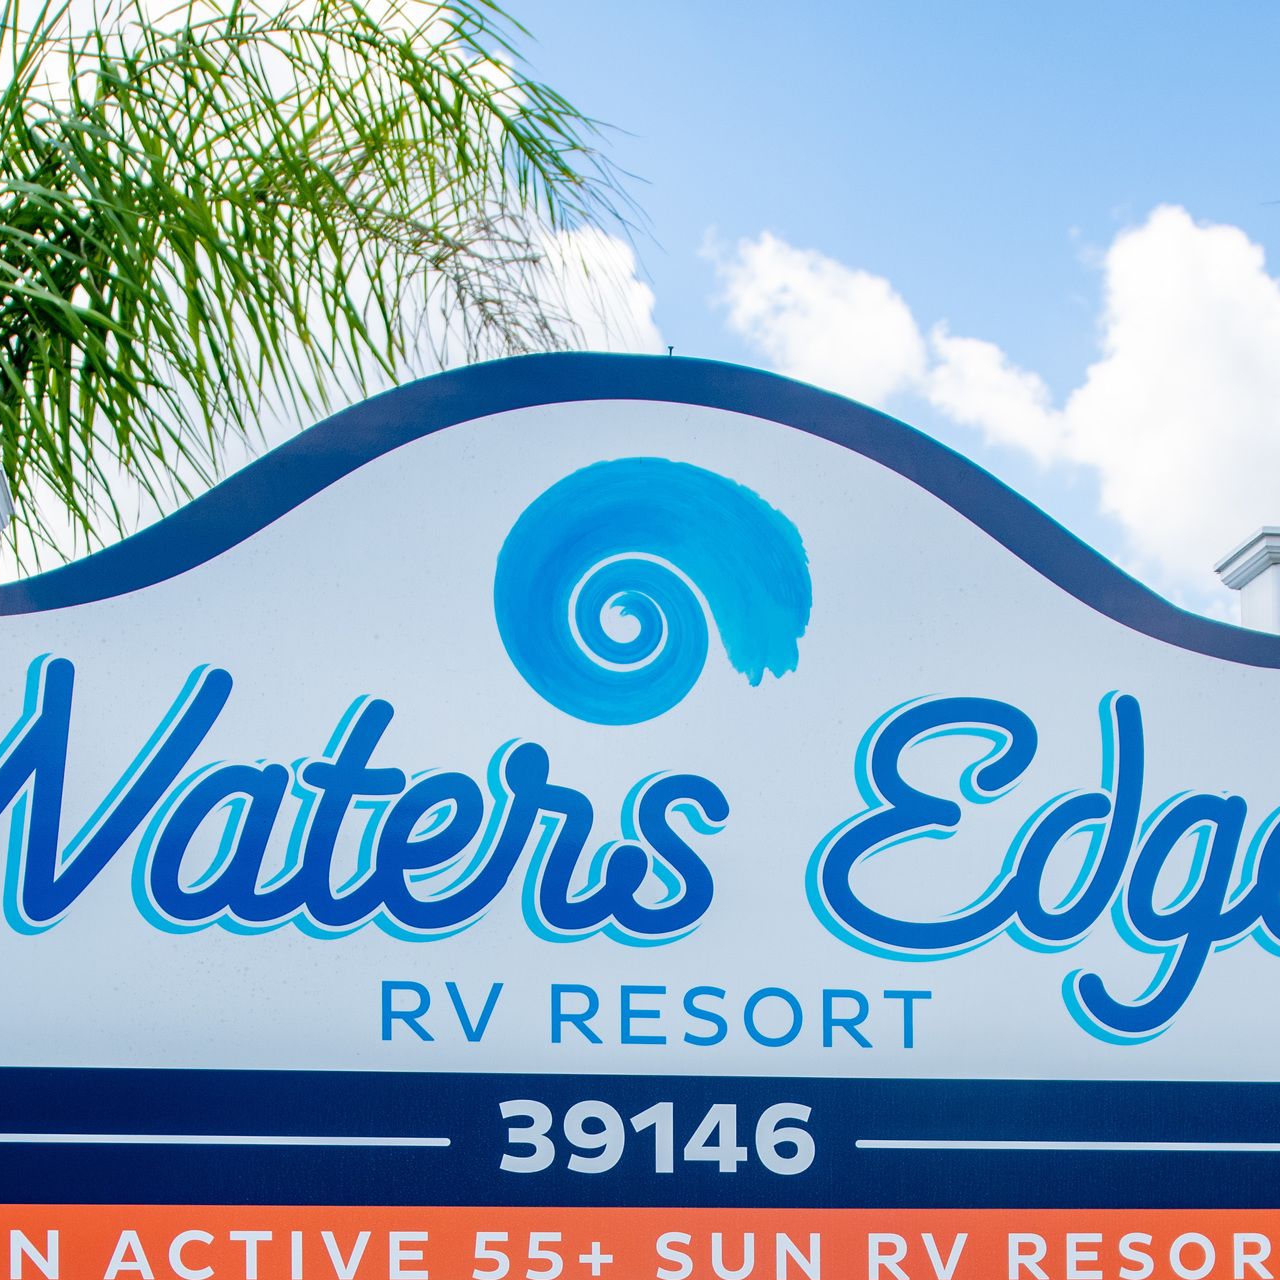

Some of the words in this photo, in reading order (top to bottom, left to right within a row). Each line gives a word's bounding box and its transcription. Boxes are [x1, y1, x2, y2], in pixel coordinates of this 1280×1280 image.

[380, 978, 505, 1045] RV
[549, 981, 934, 1051] RESORT
[498, 1098, 817, 1176] 39146
